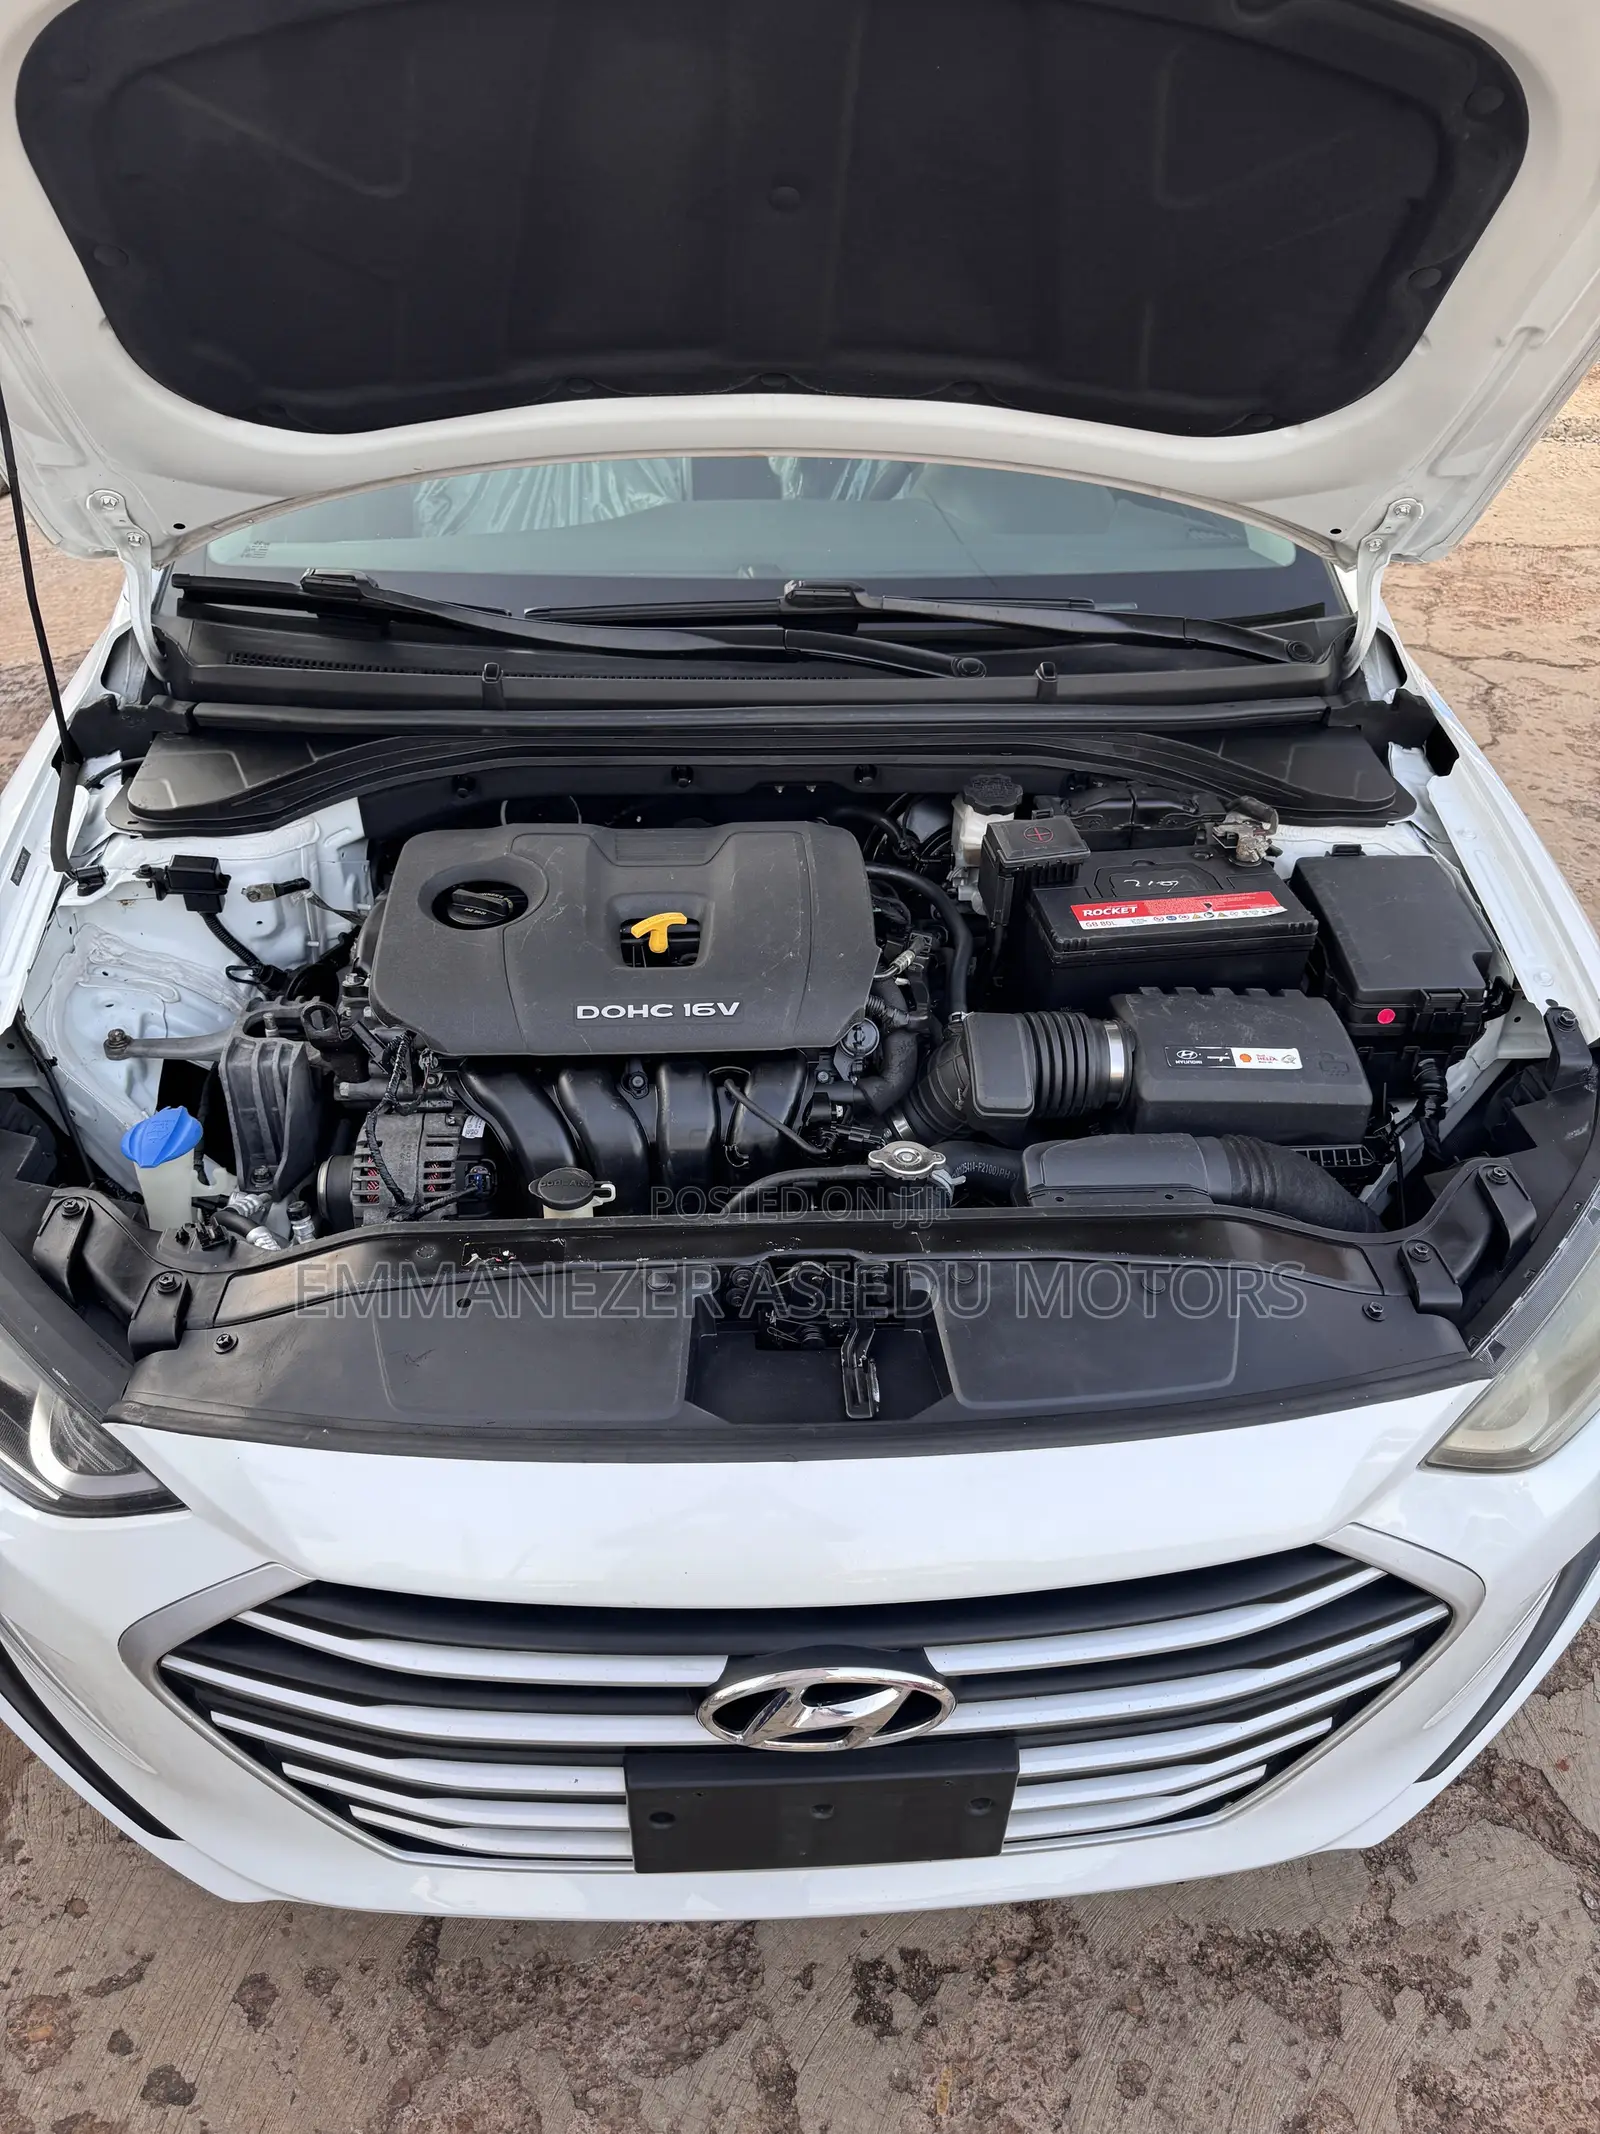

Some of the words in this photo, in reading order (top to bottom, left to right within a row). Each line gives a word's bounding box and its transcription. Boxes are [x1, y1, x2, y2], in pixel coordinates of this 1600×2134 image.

[1082, 906, 1138, 917] ROCKET
[576, 1003, 674, 1019] DOHC
[683, 1001, 740, 1017] 16V
[540, 1179, 594, 1188] COOLANT
